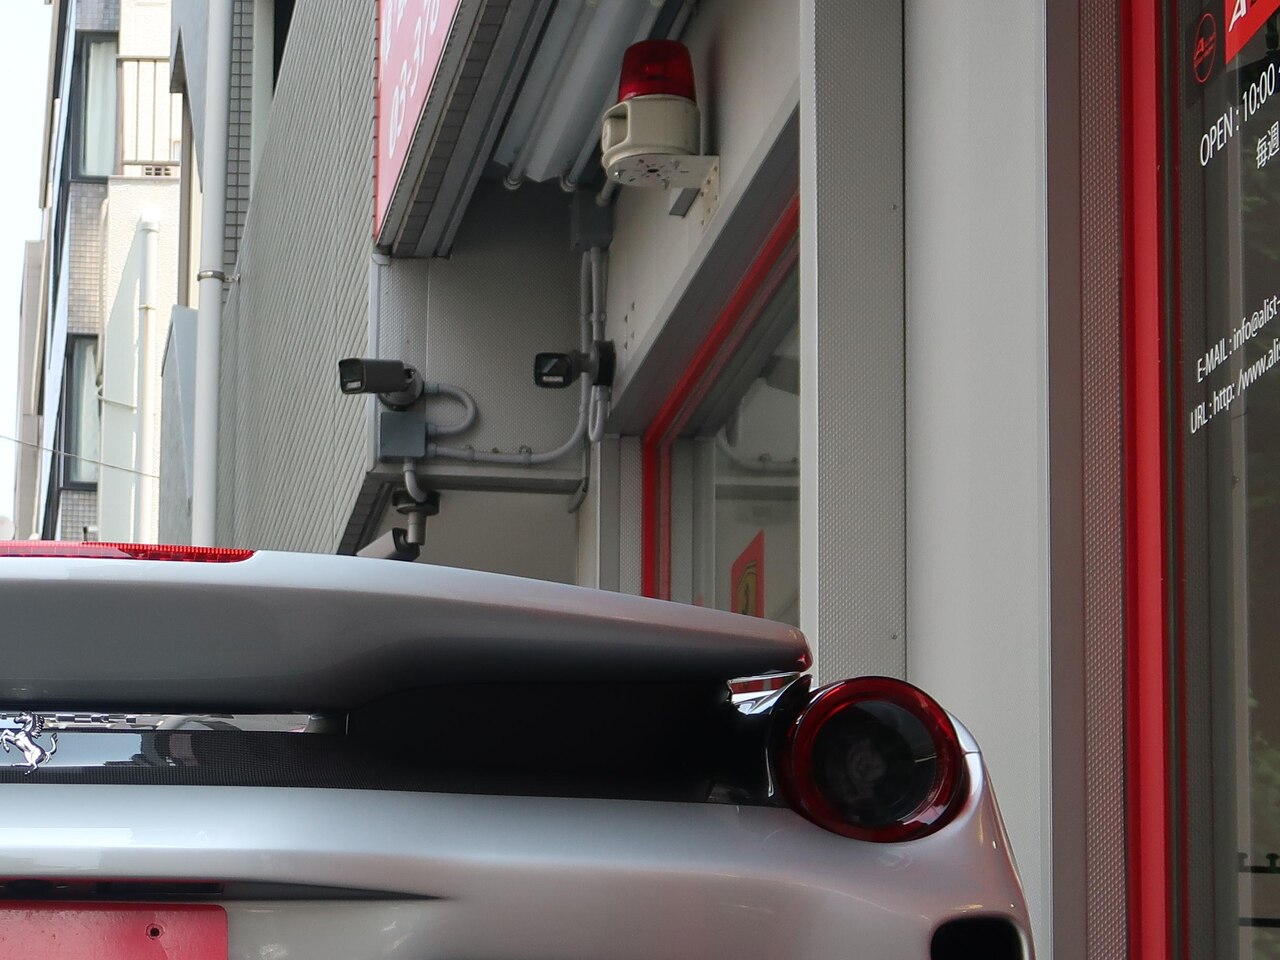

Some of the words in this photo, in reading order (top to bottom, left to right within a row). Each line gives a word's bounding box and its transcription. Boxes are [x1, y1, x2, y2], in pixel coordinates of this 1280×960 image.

[1200, 106, 1233, 166] OPEN
[1243, 63, 1276, 122] 10:00
[1197, 337, 1228, 383] E-MAIL
[1190, 401, 1208, 434] URL
